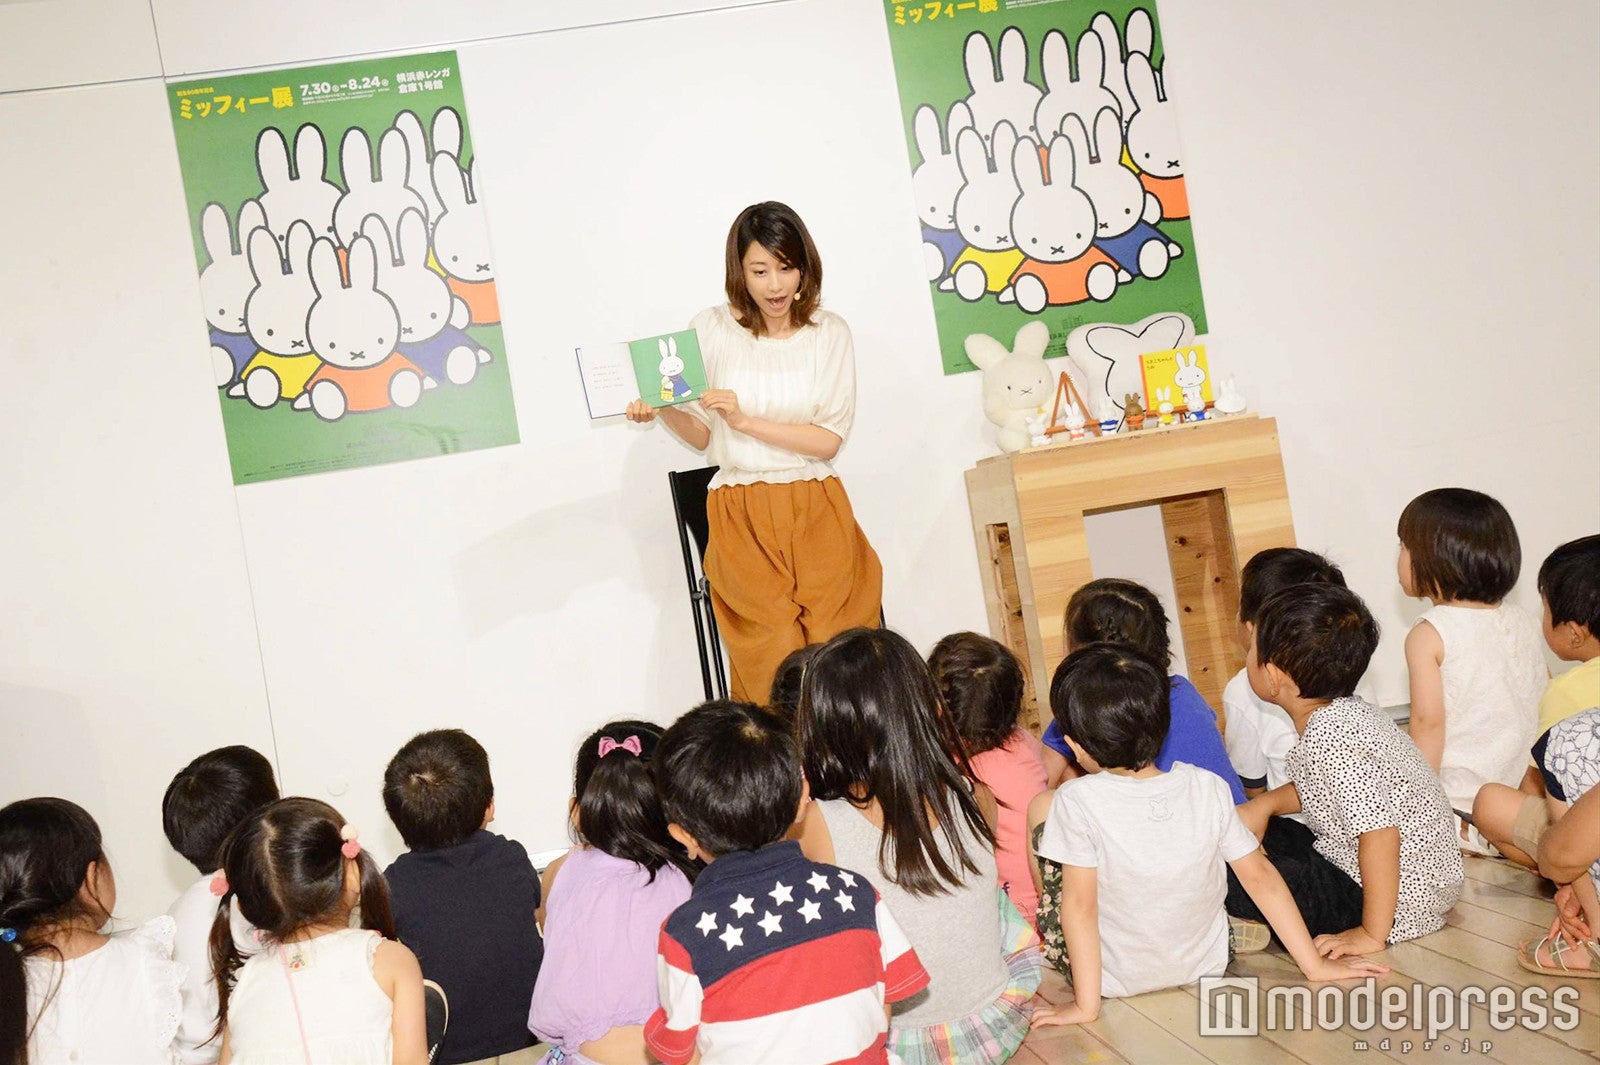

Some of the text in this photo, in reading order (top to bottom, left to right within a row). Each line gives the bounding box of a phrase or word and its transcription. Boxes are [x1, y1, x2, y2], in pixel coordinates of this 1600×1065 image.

[396, 67, 451, 84] 横浜赤レンガ
[180, 86, 294, 119] ミッフィー展
